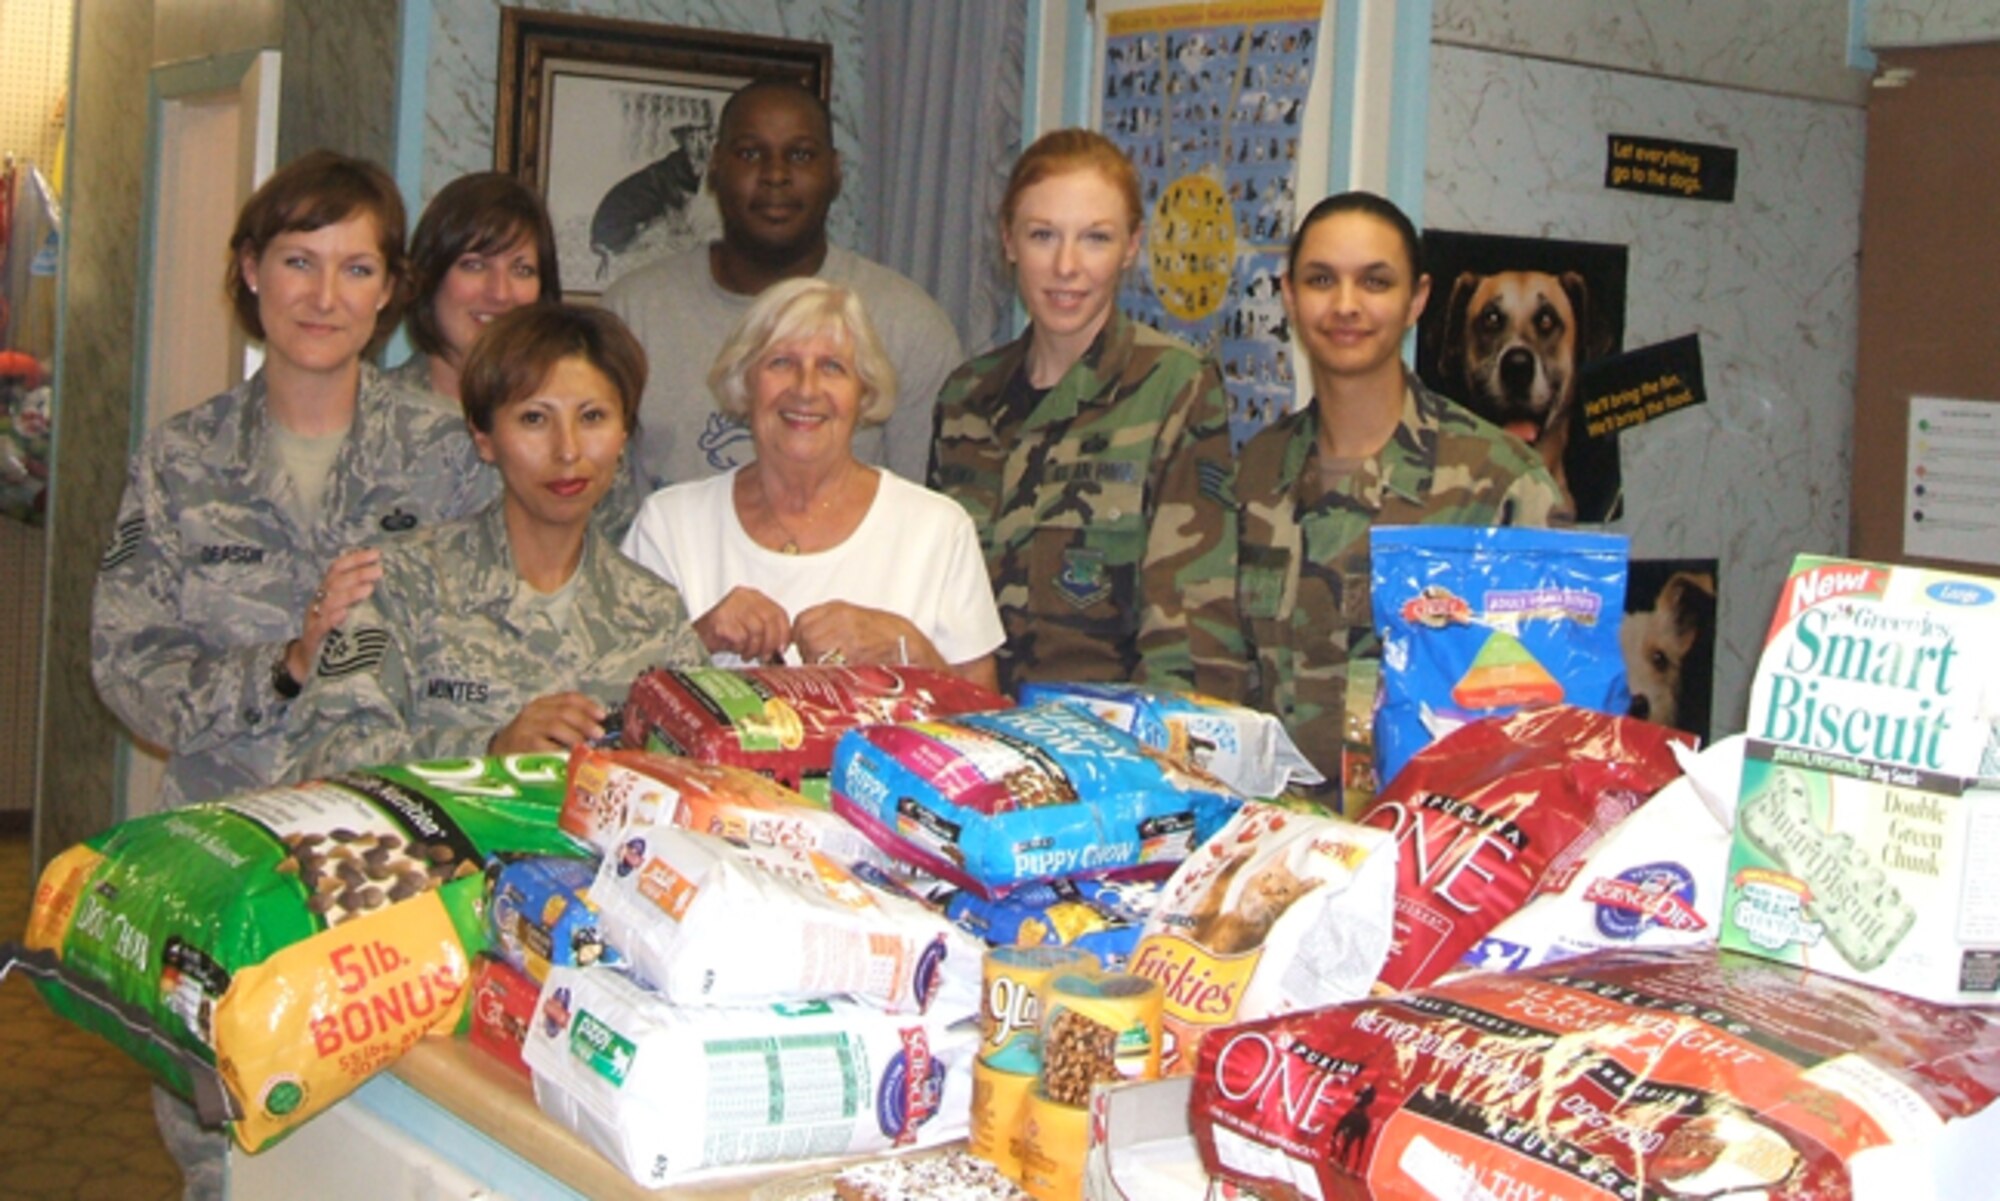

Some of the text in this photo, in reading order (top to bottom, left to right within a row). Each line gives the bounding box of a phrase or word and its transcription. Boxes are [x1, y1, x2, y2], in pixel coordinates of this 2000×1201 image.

[1613, 140, 1699, 173] Let everything
[1612, 166, 1702, 195] go to the dogs.
[1610, 388, 1640, 409] bring
[1641, 381, 1659, 397] the
[1616, 407, 1646, 427] bring
[1646, 400, 1665, 416] the
[1791, 568, 1871, 618] New!
[1785, 608, 1960, 697] Smart
[428, 679, 490, 704] MONTES
[998, 714, 1098, 758] HOW
[1760, 672, 1951, 770] Biscuit
[1883, 790, 1947, 824] Double
[1889, 819, 1944, 849] Green
[1015, 848, 1080, 878] PUPPY
[1881, 843, 1940, 878] Chunk
[1132, 944, 1236, 1018] Friskies
[309, 964, 461, 1060] BONUS
[1627, 1012, 1764, 1064] WEGHT
[899, 1026, 931, 1112] SCIENCE
[1215, 1031, 1348, 1135] ONE
[1561, 1094, 1604, 1128] DOG
[1485, 1124, 1579, 1165] ADULT
